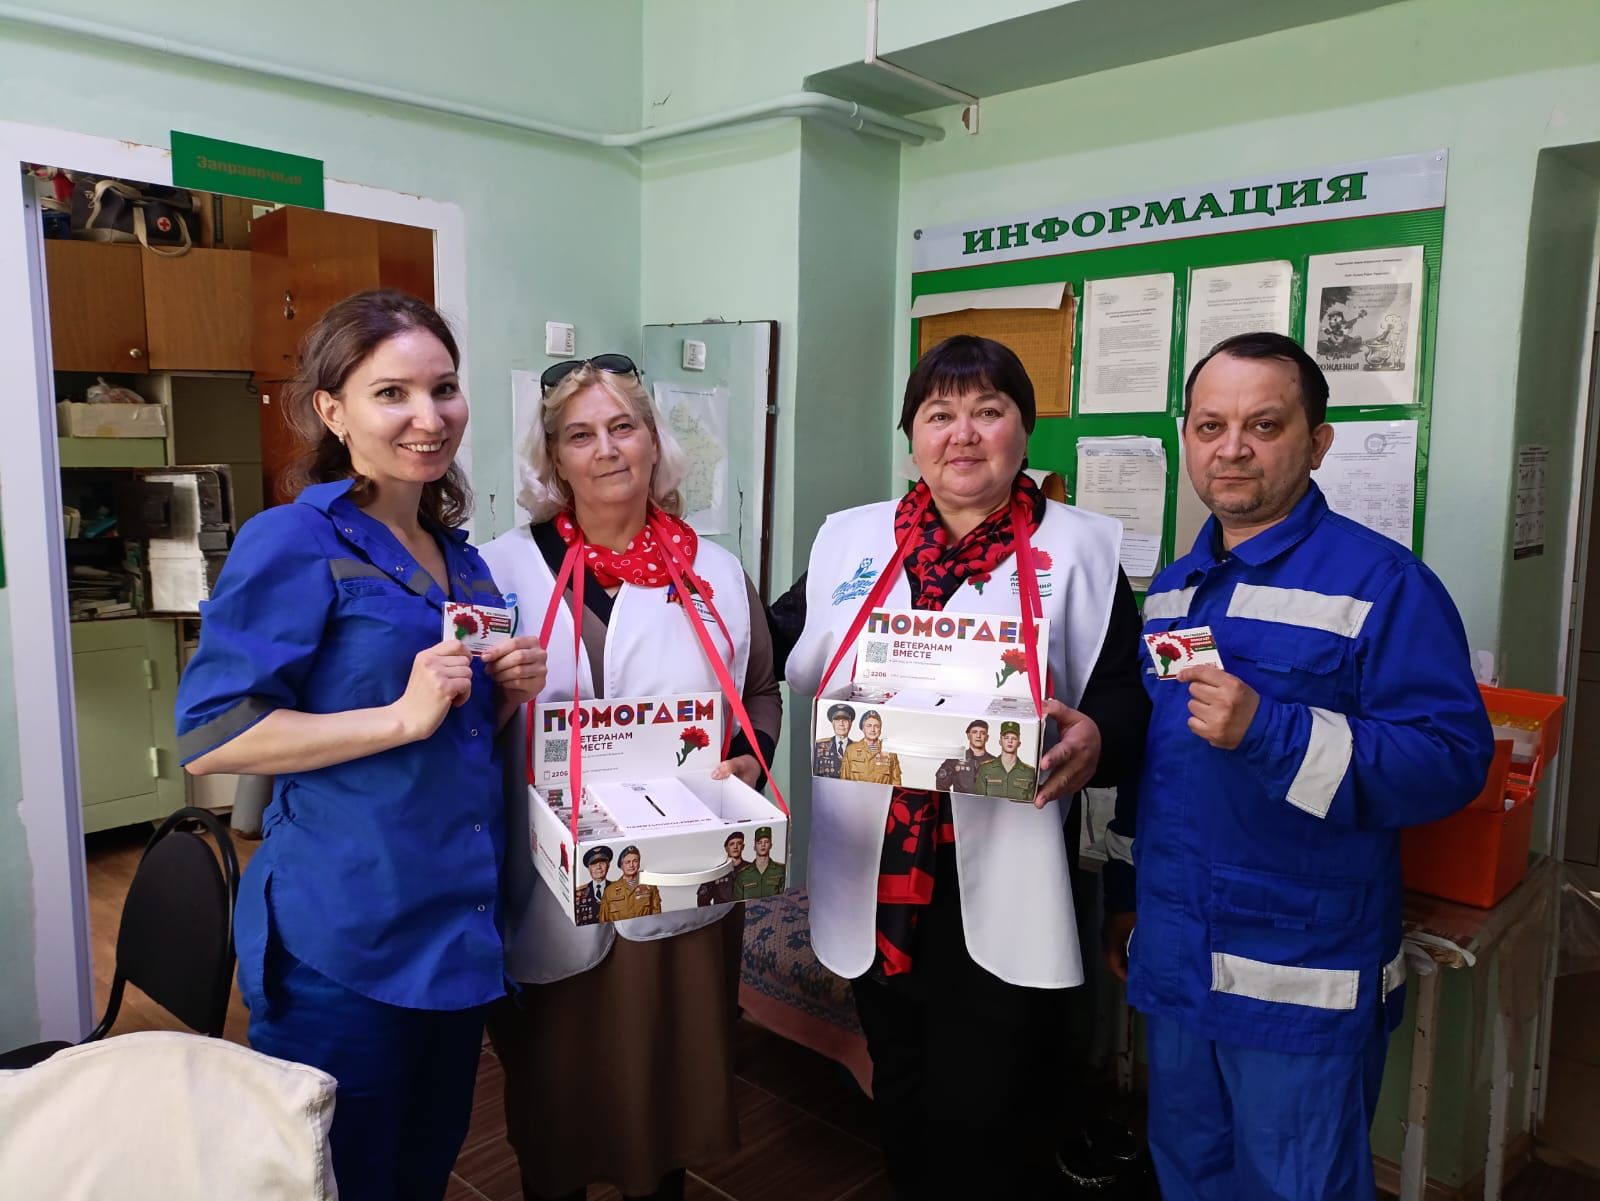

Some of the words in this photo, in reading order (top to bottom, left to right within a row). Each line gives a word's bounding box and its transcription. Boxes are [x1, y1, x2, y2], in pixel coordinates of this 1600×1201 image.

[962, 171, 1369, 255] ИНФОРМАЦИЯ
[893, 640, 953, 652] ВЕТЕРАНАМ
[892, 649, 932, 660] ВМЕСТЕ
[543, 698, 714, 733] ПОМОГАЕМ
[580, 732, 633, 744] ЕТЕРАНАМ
[580, 742, 613, 752] МЕСТЕ
